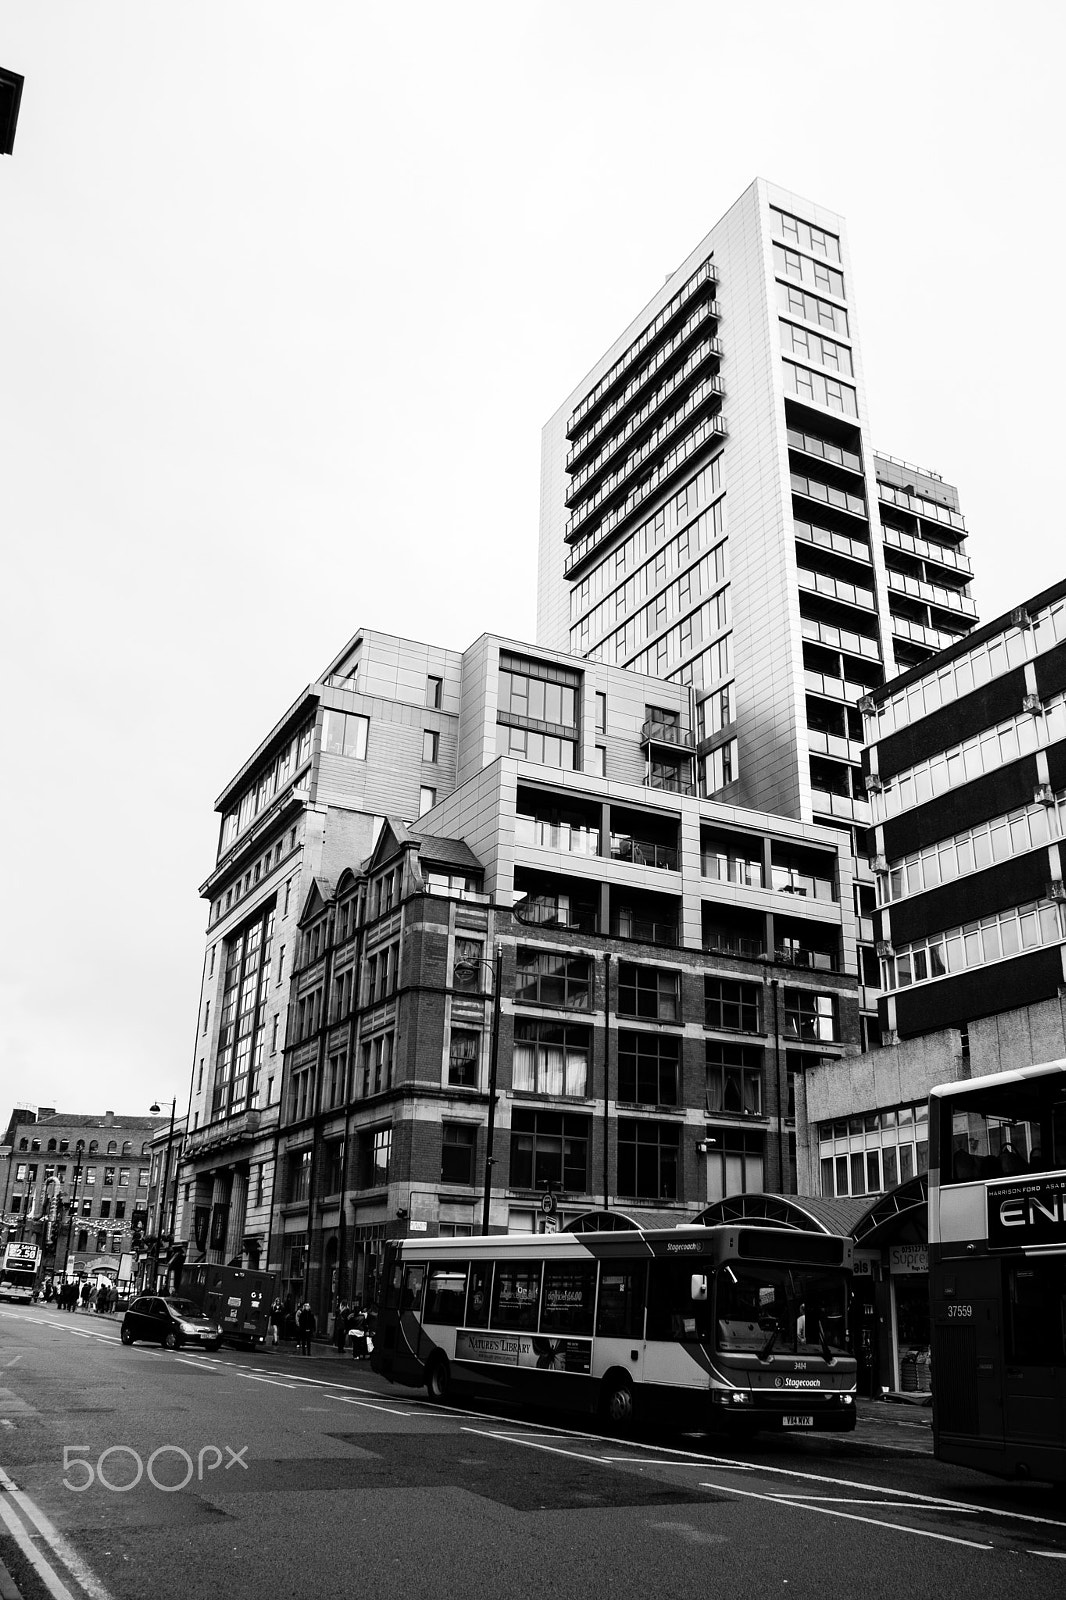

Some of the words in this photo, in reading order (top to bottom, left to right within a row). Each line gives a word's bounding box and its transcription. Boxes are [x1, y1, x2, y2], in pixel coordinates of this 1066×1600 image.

[989, 1188, 1021, 1196] HARRISON
[1022, 1185, 1041, 1193] FORD
[999, 1194, 1066, 1226] EN
[666, 1243, 697, 1252] Stagecoach
[892, 1250, 928, 1267] Supre
[853, 1260, 868, 1273] als
[947, 1305, 972, 1317] 37559
[468, 1336, 499, 1352] NATURE'S
[500, 1340, 531, 1354] LIBRARY
[784, 1377, 821, 1389] Stagecoach
